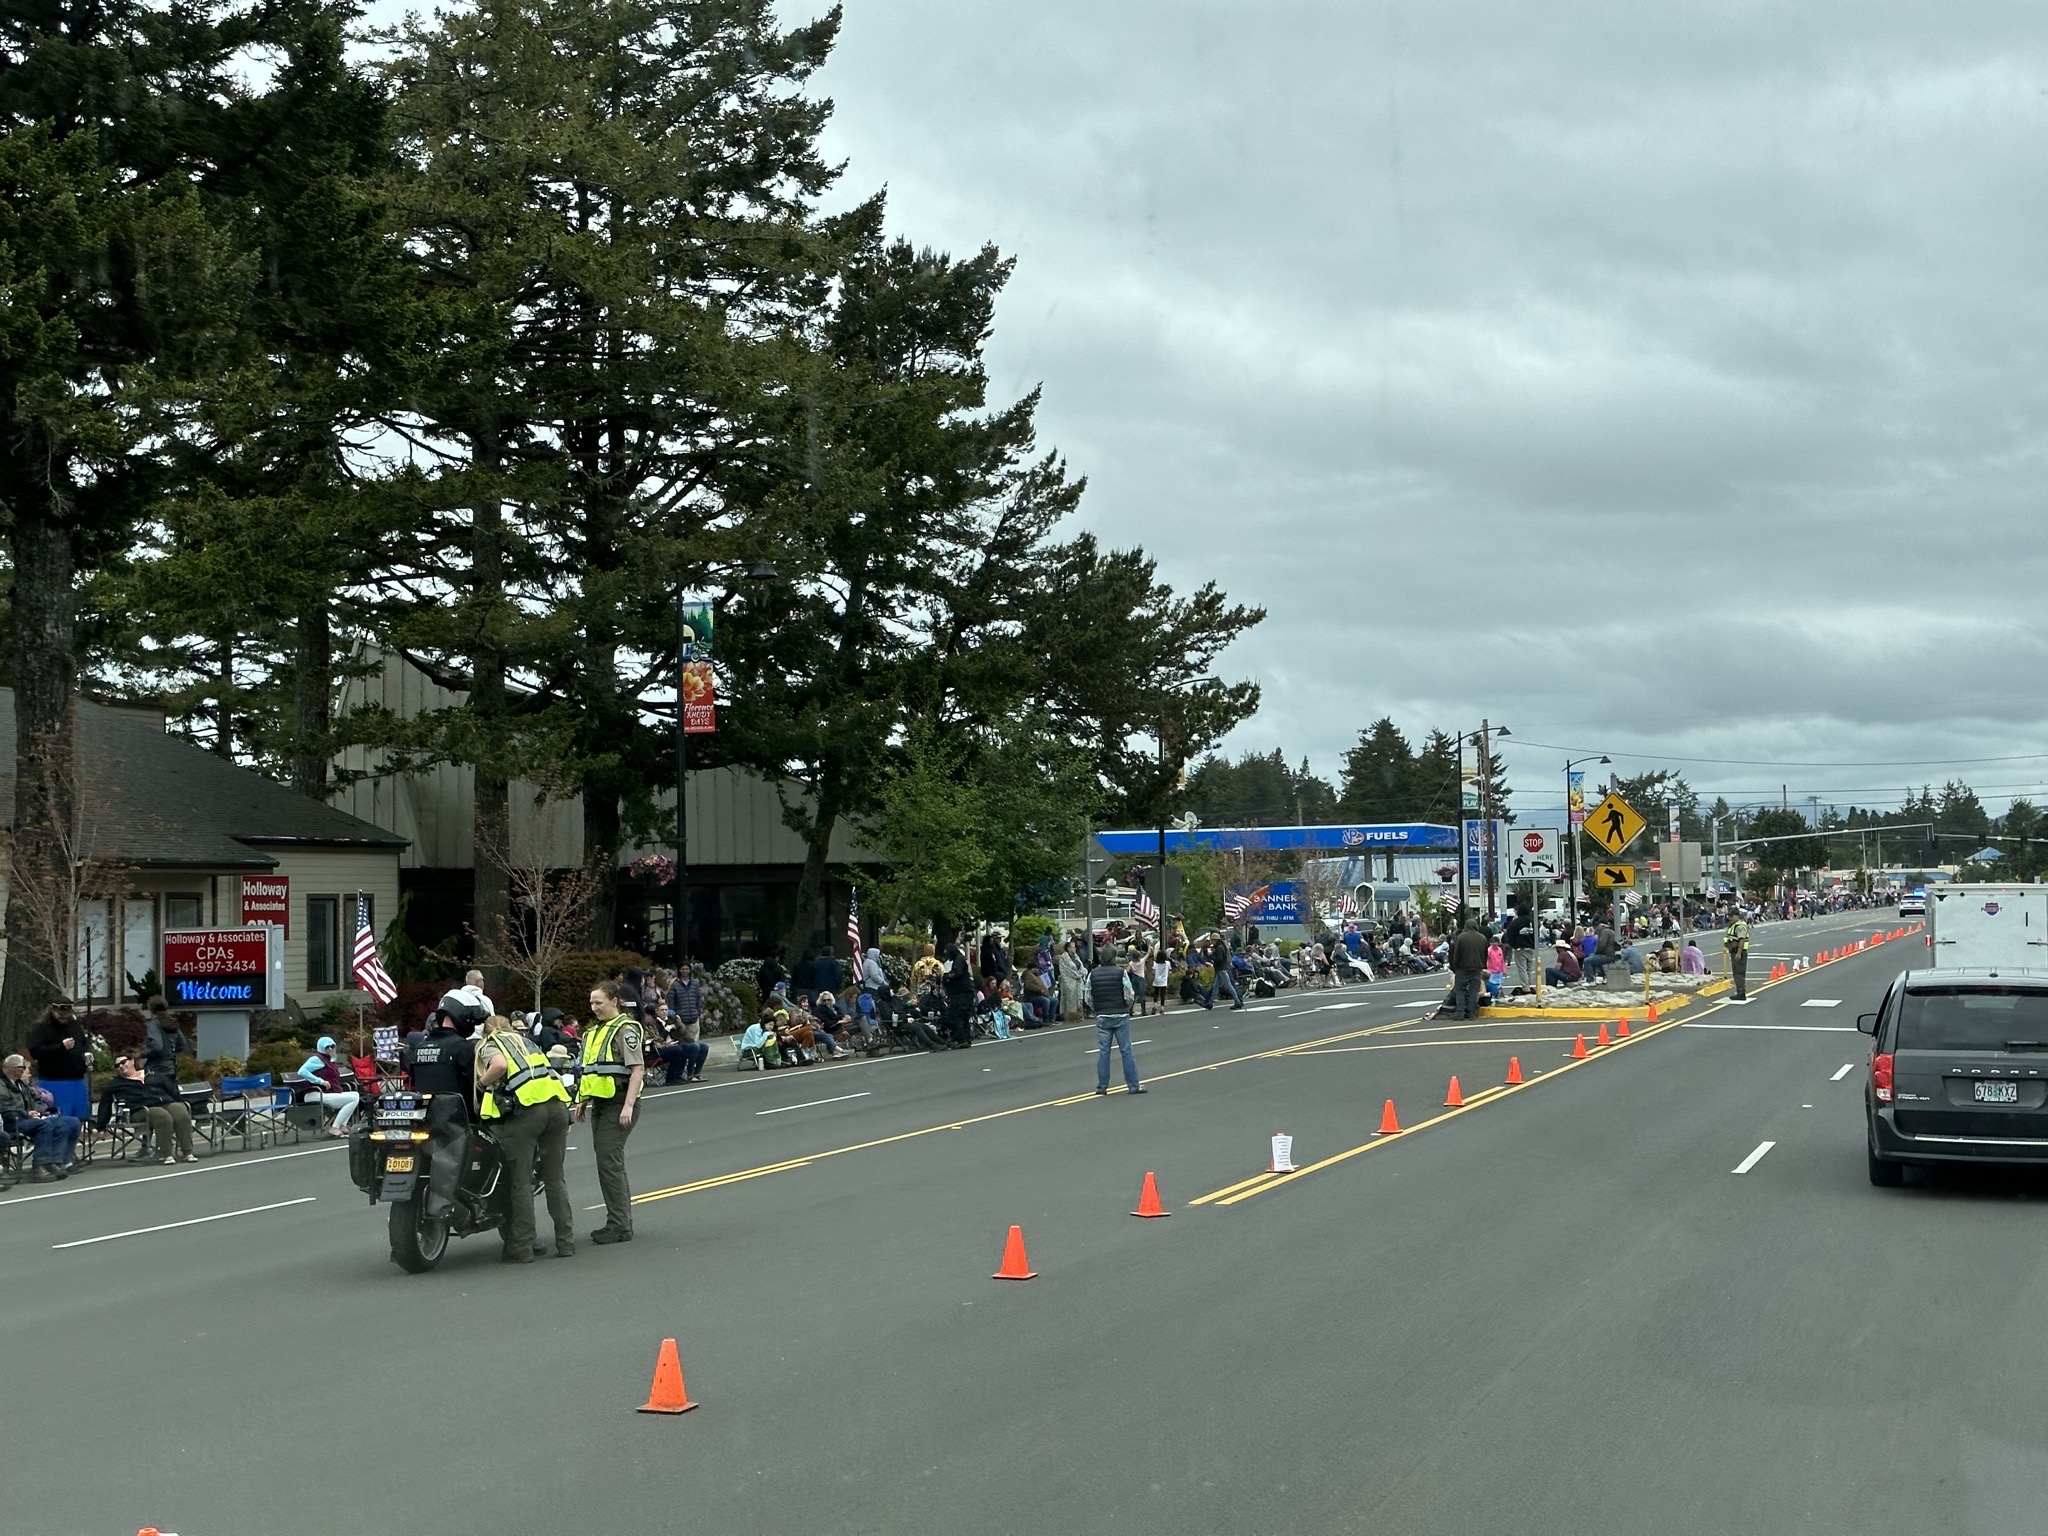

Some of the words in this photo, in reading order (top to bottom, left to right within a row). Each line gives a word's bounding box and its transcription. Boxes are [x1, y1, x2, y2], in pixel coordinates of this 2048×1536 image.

[1366, 831, 1409, 840] FUELS
[1524, 838, 1543, 848] STOP
[243, 881, 287, 899] Holloway
[244, 900, 249, 910] &
[251, 900, 285, 910] Associates
[1268, 902, 1297, 911] BANK
[165, 934, 206, 946] Holloway
[208, 933, 215, 944] &
[217, 931, 265, 943] Associates
[196, 946, 234, 959] CPAs
[174, 960, 257, 973] 541-997-3434
[176, 981, 252, 1000] Welcome
[1975, 1085, 1993, 1097] 678
[1998, 1085, 2016, 1098] KXZ
